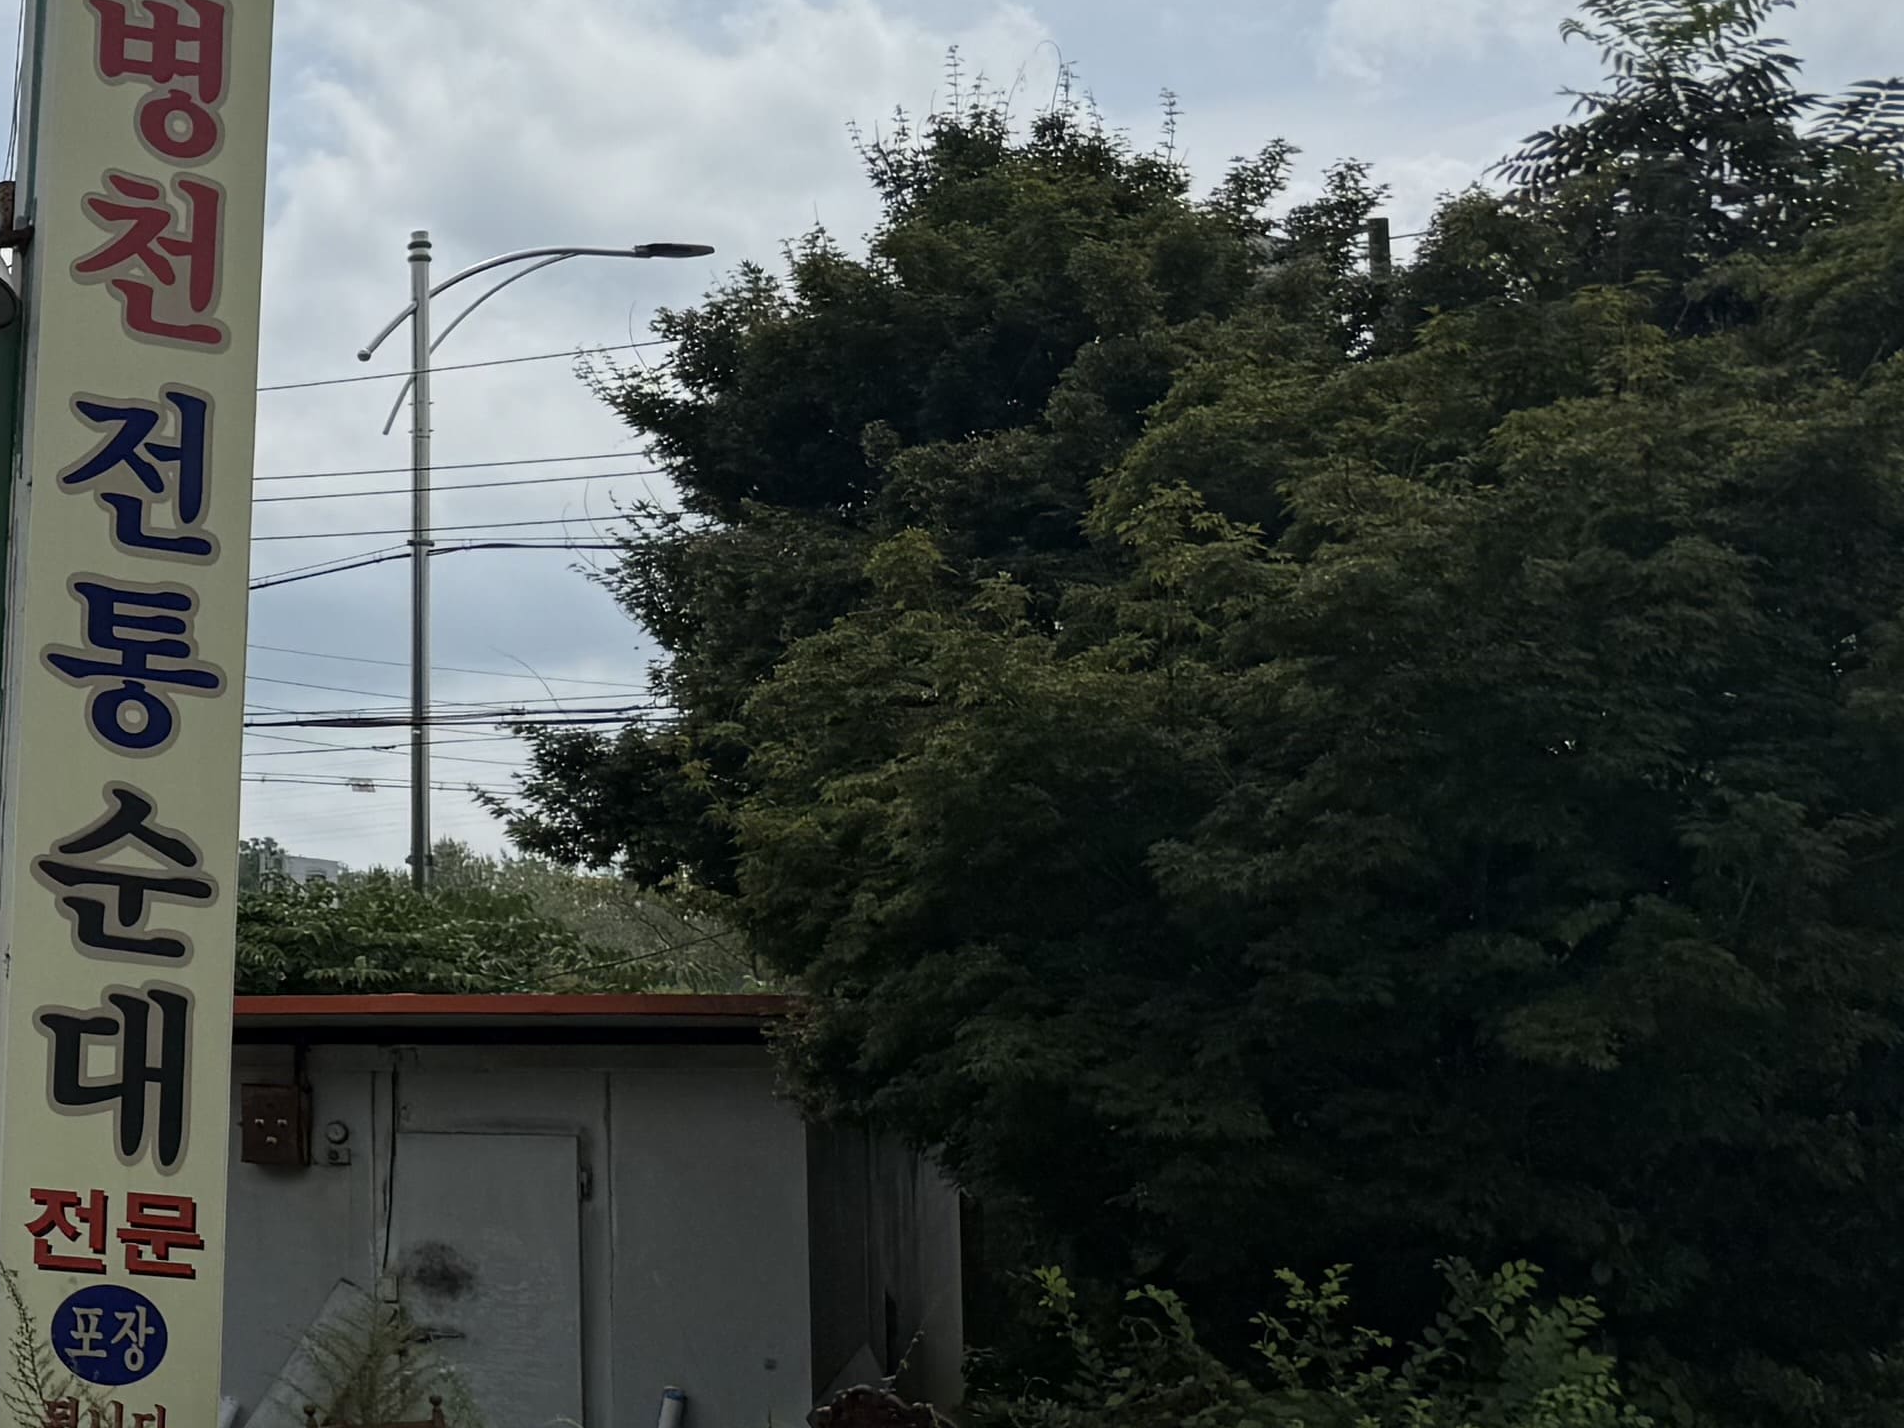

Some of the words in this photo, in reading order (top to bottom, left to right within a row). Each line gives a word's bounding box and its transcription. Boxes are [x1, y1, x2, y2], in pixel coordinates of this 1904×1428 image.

[47, 391, 220, 749] 전통
[37, 787, 213, 1167] 순대
[24, 1187, 205, 1280] 전문
[64, 1305, 156, 1372] 포장
